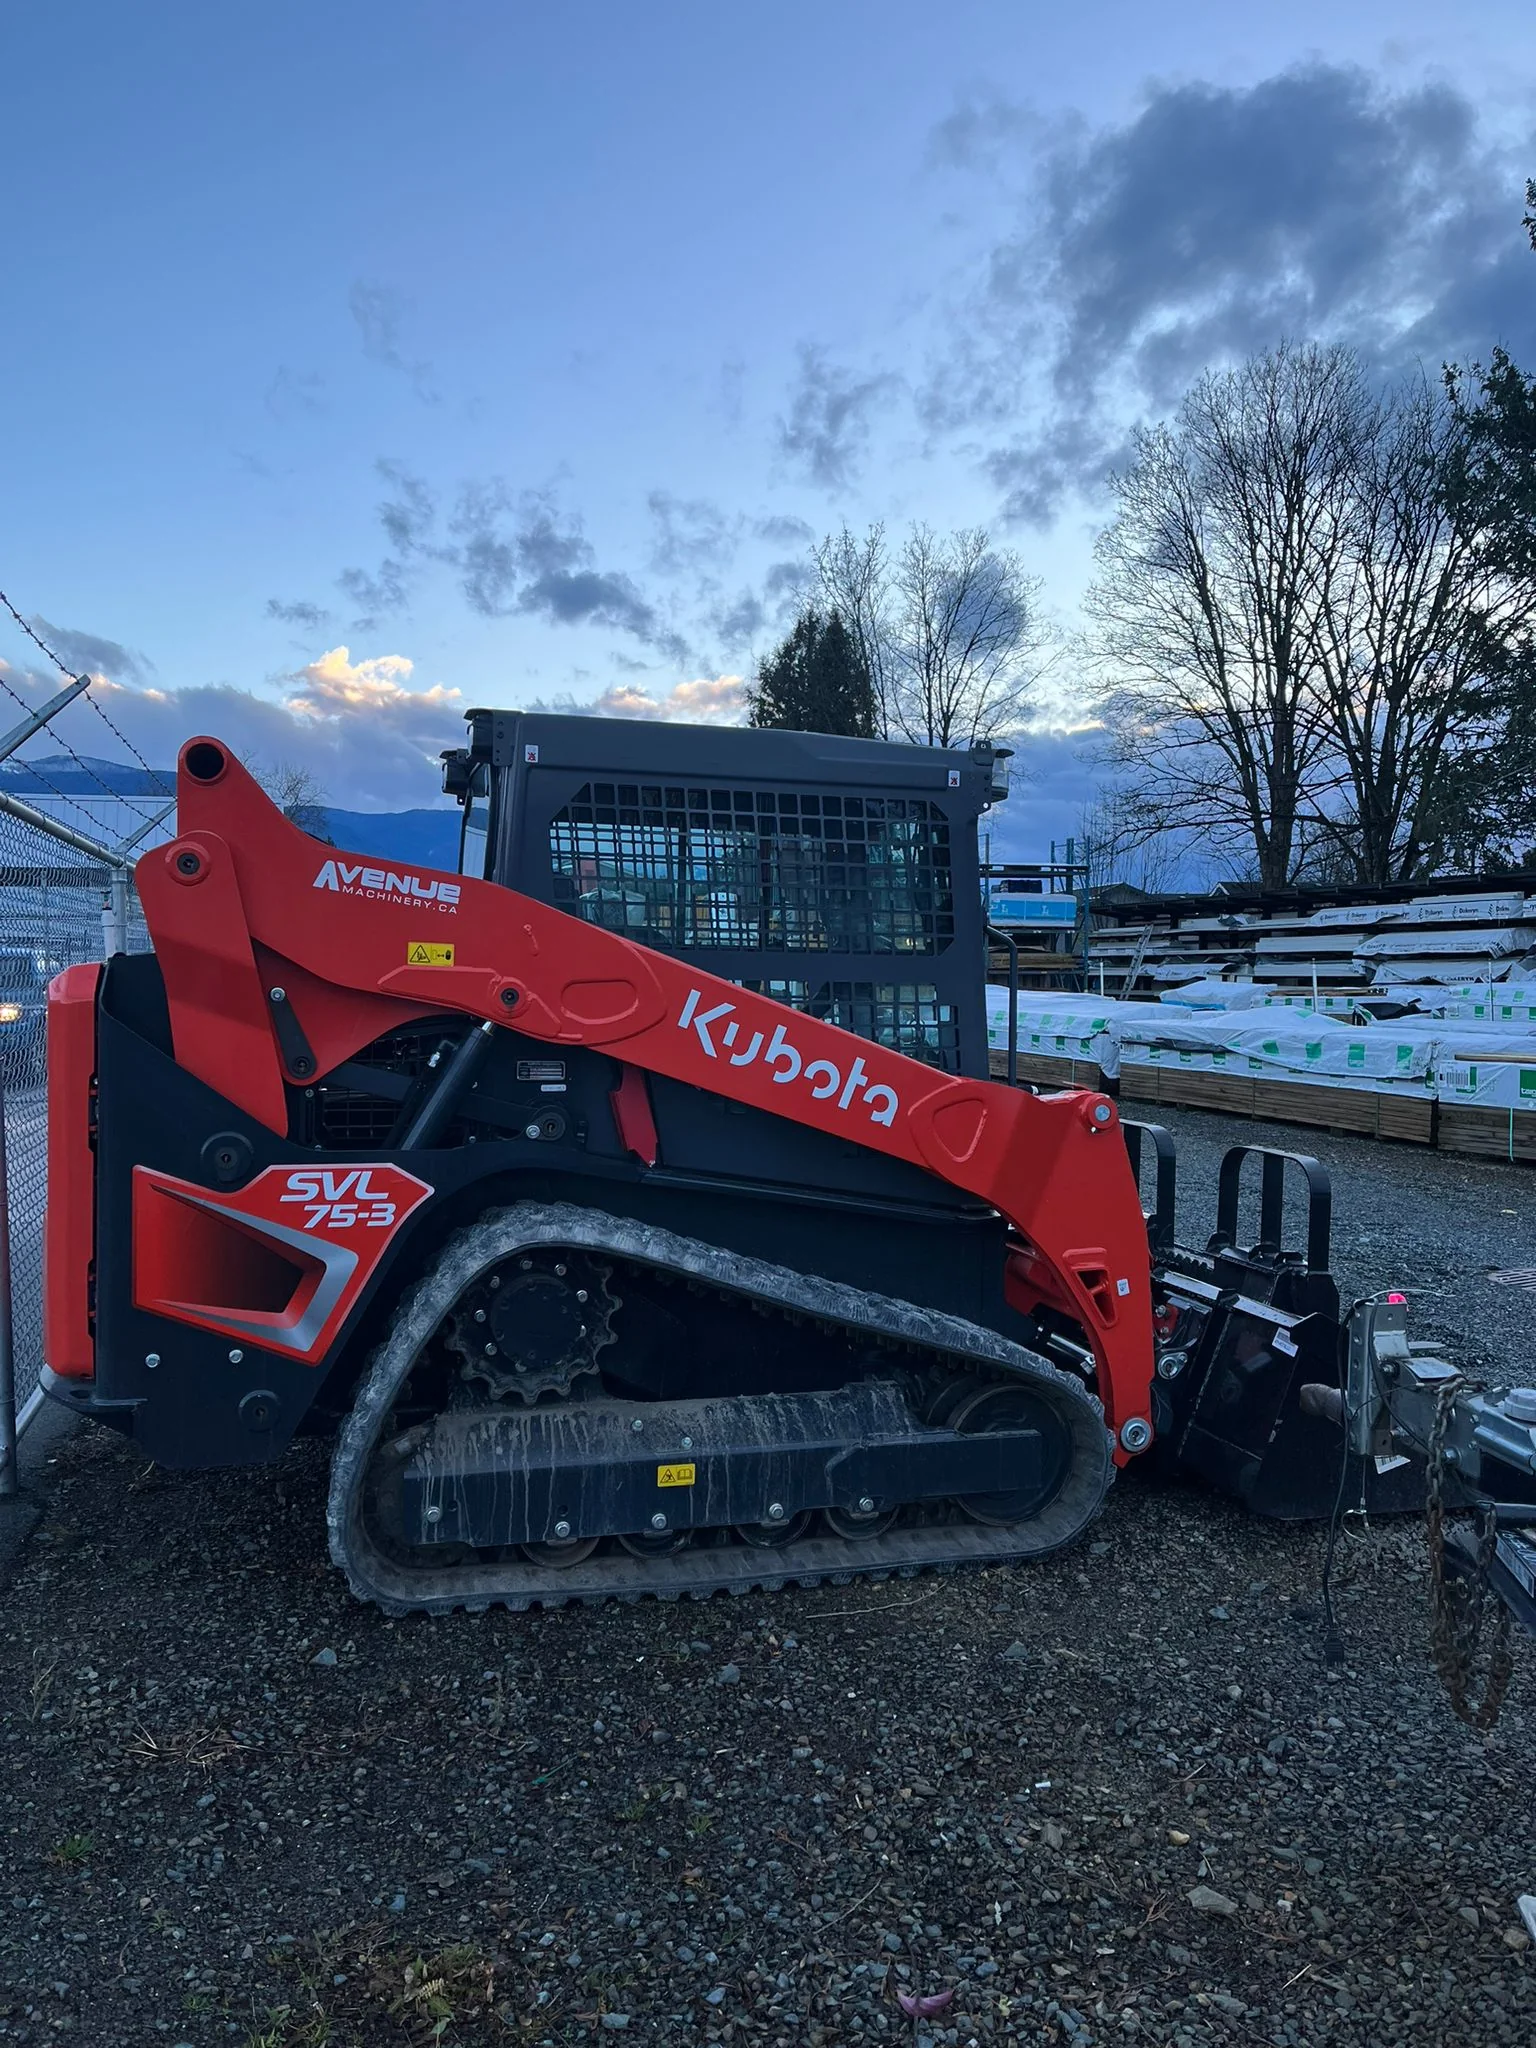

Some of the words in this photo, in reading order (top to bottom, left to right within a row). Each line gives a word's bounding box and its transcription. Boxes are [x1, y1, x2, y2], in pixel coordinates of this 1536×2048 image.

[313, 860, 461, 904] AVENUE
[342, 885, 457, 914] MACHINERY.CA
[677, 989, 899, 1127] Kubota
[280, 1171, 389, 1202] SVL
[303, 1203, 397, 1229] 75-3
